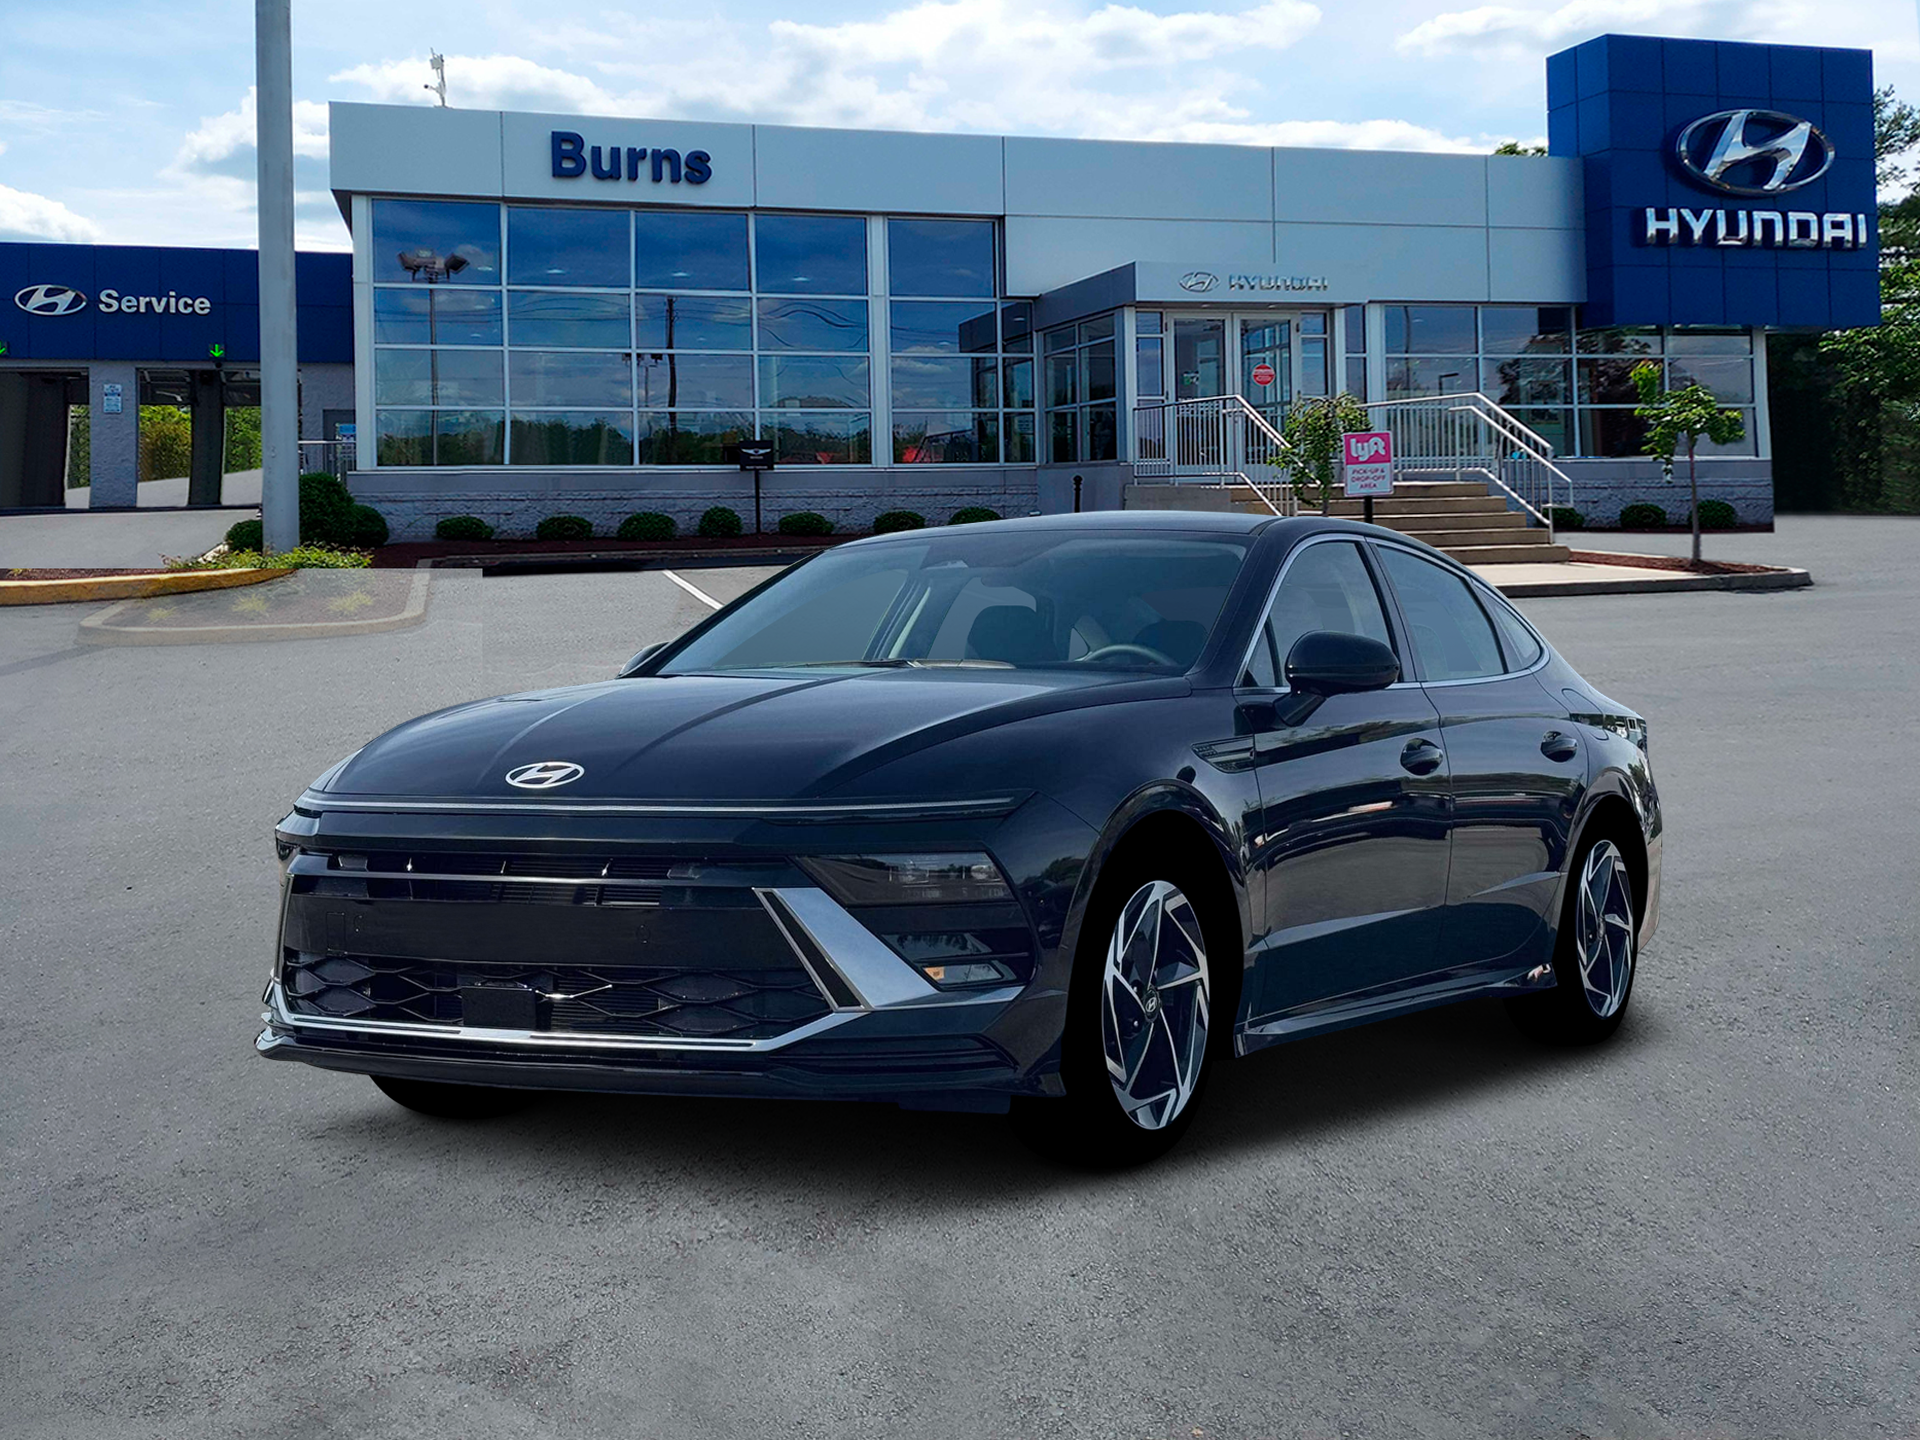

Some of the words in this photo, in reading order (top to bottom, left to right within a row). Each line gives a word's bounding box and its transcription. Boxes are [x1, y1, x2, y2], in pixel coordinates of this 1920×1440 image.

[551, 130, 712, 185] Burns
[1645, 207, 1868, 248] HYUNDAI
[1228, 274, 1329, 292] HYUNDAI
[98, 289, 212, 315] Service
[1350, 437, 1386, 462] lyft
